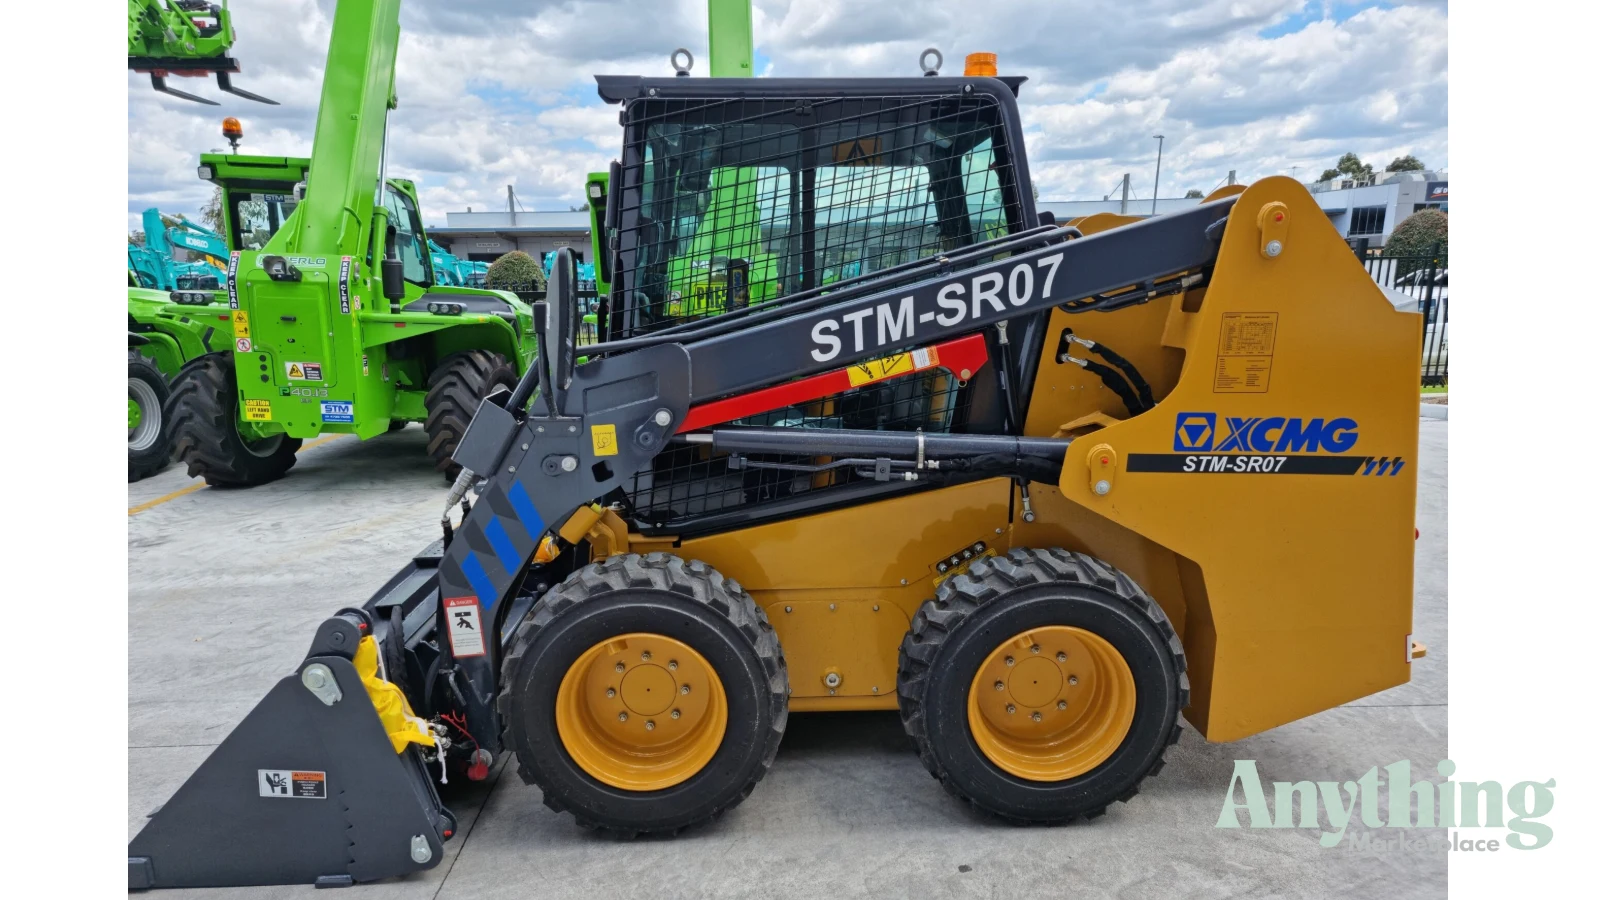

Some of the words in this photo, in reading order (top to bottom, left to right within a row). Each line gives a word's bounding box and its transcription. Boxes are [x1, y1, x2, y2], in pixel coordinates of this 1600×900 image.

[228, 256, 239, 277] KEEP
[340, 261, 350, 282] KEEP
[228, 279, 239, 309] CLEAR
[340, 284, 350, 313] CLEAR
[810, 253, 1064, 363] STM-SR07
[324, 404, 349, 413] STM
[1213, 417, 1359, 453] XCMG
[1182, 456, 1287, 473] STM-SR07
